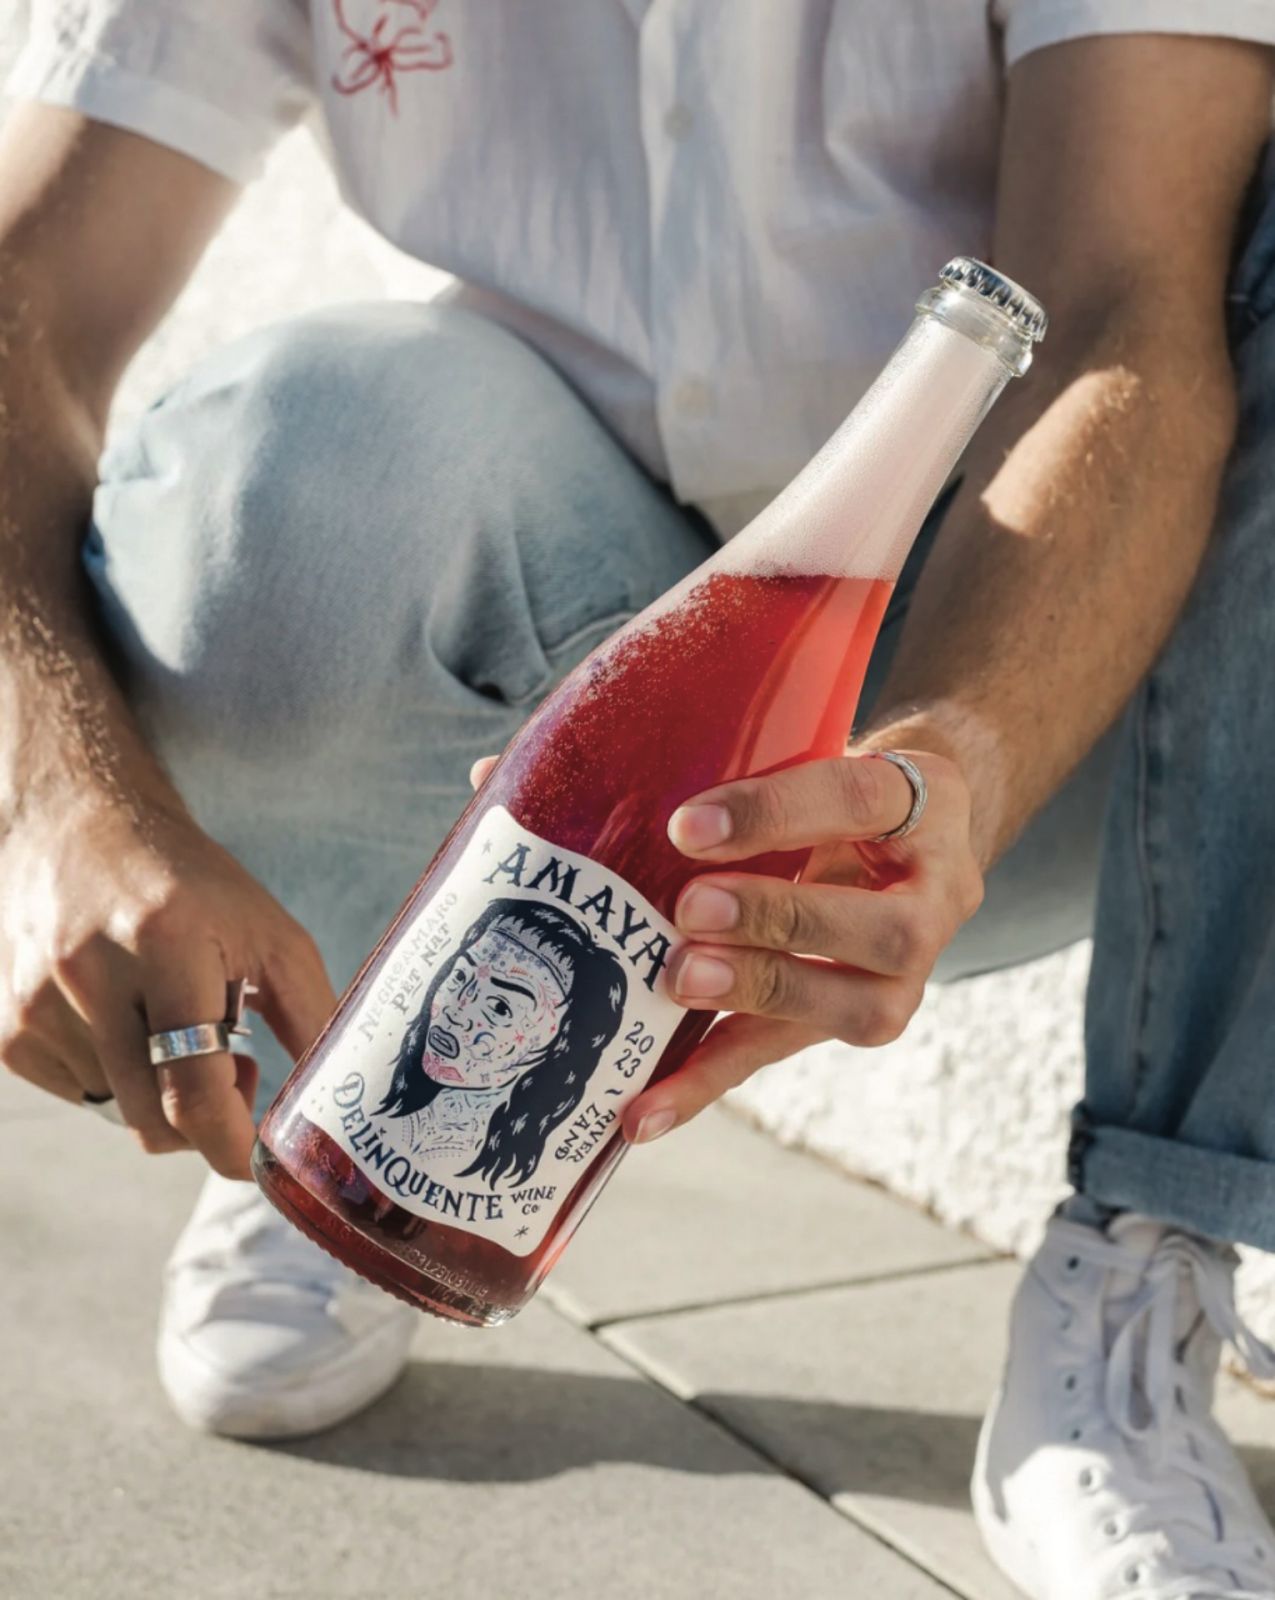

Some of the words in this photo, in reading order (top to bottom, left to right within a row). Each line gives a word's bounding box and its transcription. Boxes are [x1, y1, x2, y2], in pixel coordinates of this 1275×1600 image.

[482, 842, 672, 992] AMAYA
[357, 892, 458, 1042] NEGROAMARO
[614, 1048, 642, 1078] 23
[625, 1021, 655, 1054] 20
[333, 1071, 504, 1222] DELINQUENTE
[554, 1101, 601, 1160] LAND
[565, 1109, 617, 1164] RIVER
[510, 1185, 557, 1204] WINE
